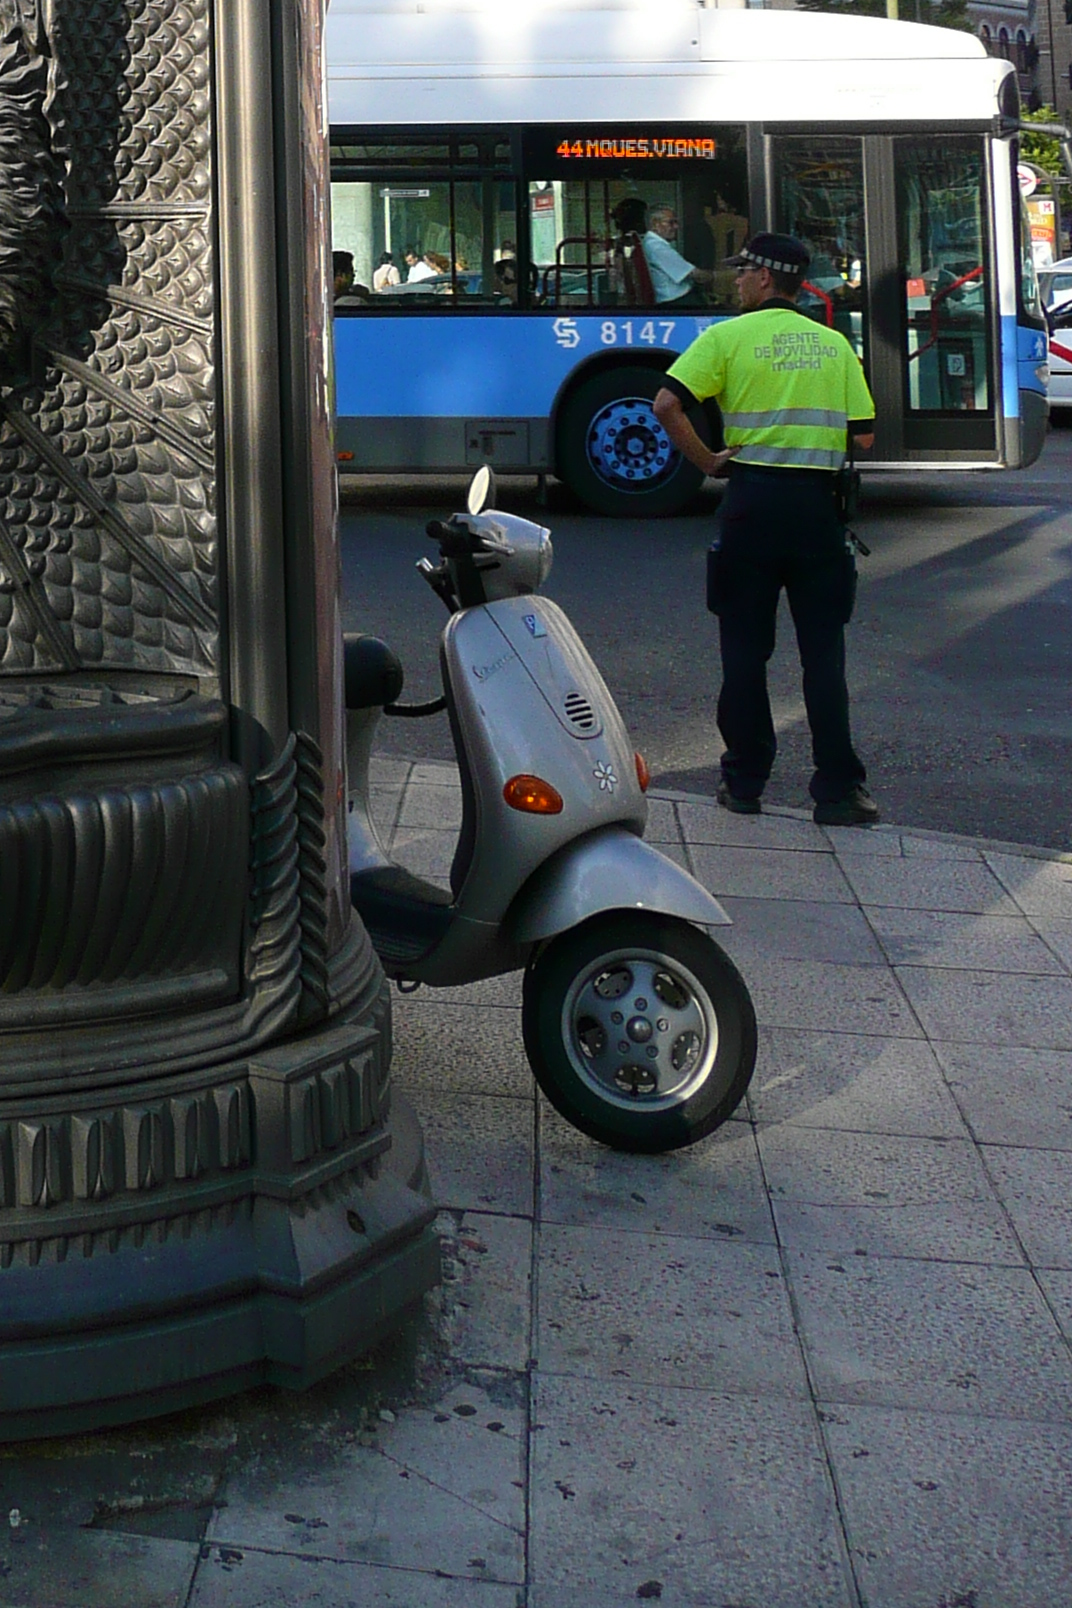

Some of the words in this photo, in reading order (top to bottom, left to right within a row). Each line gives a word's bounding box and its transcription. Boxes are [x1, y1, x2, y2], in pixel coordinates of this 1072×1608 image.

[556, 140, 584, 157] 44
[600, 321, 676, 344] 8147
[772, 333, 819, 345] AGENTE
[754, 347, 771, 359] DE
[774, 344, 838, 357] MOVILIDAD
[772, 358, 821, 372] madrid
